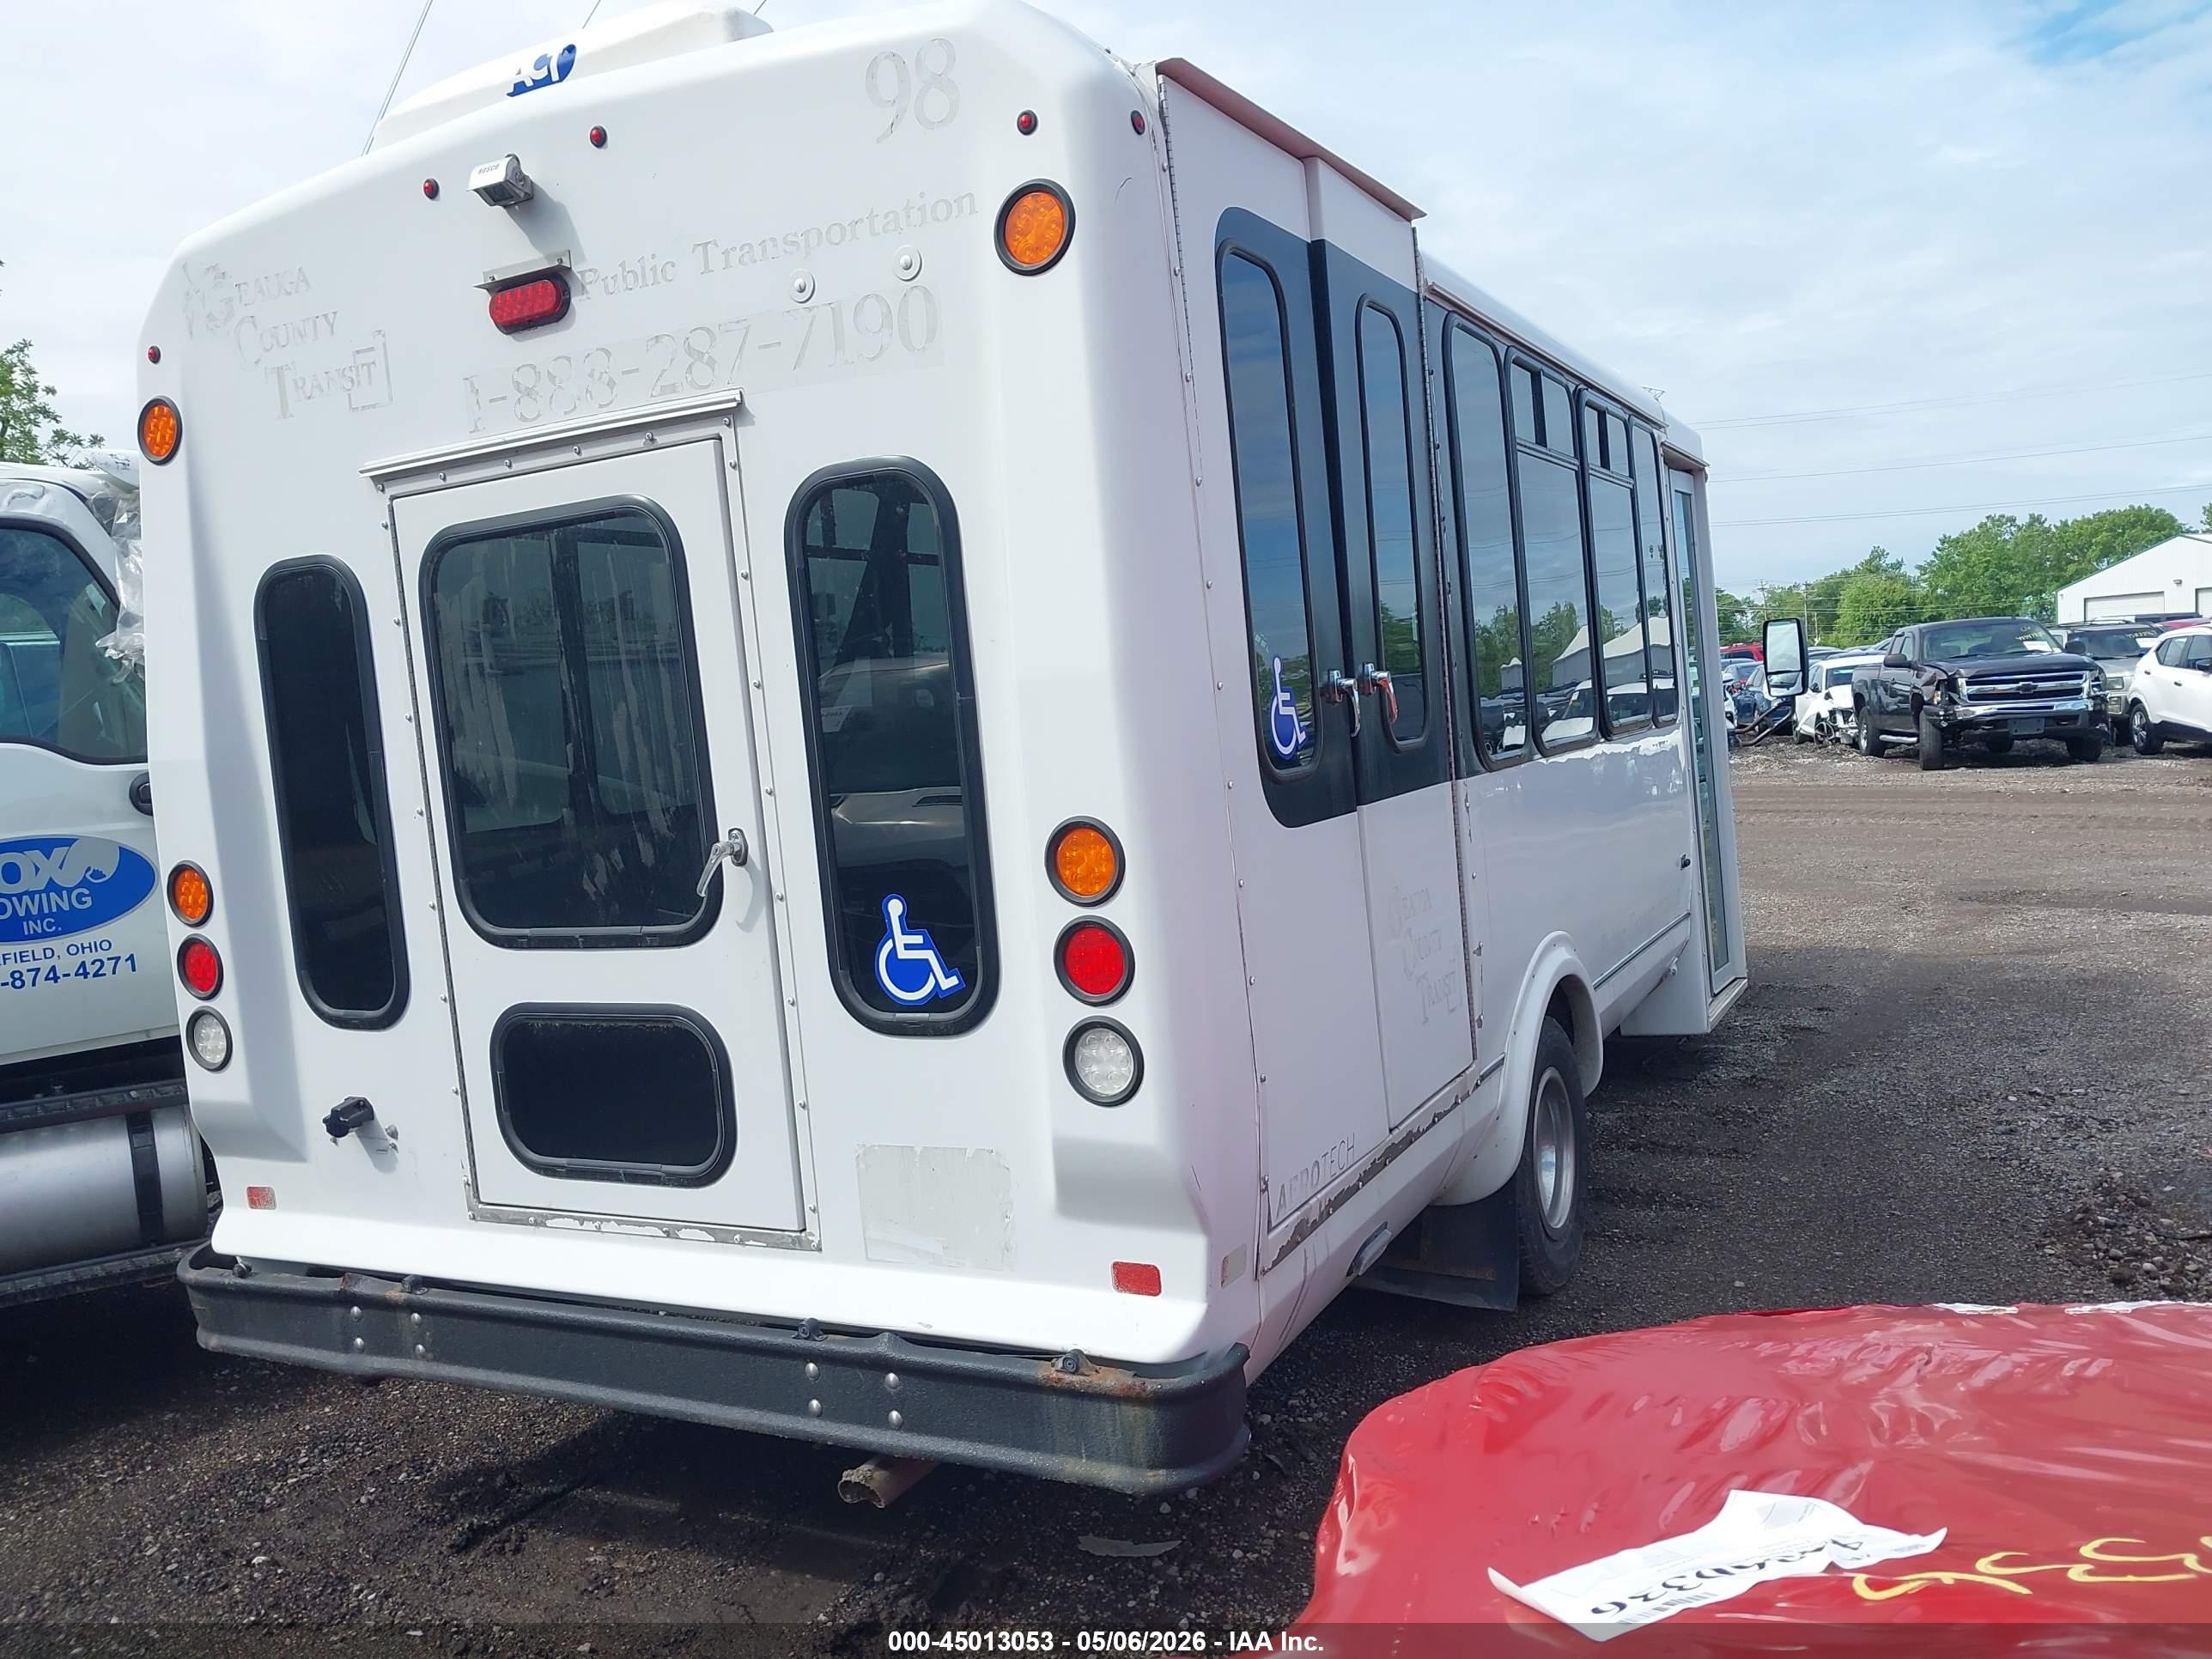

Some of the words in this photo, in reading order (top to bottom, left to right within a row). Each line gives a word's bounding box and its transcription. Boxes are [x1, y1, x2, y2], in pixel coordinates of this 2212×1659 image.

[865, 38, 961, 144] 98
[577, 253, 677, 301] Public
[692, 190, 979, 276] Transportation
[234, 310, 339, 372] COUNTY
[464, 284, 937, 434] 1-888-287-7190
[264, 360, 378, 420] TRANSIT
[0, 947, 61, 966] FIELD,
[66, 939, 112, 956] OHIO
[22, 918, 63, 935] INC.
